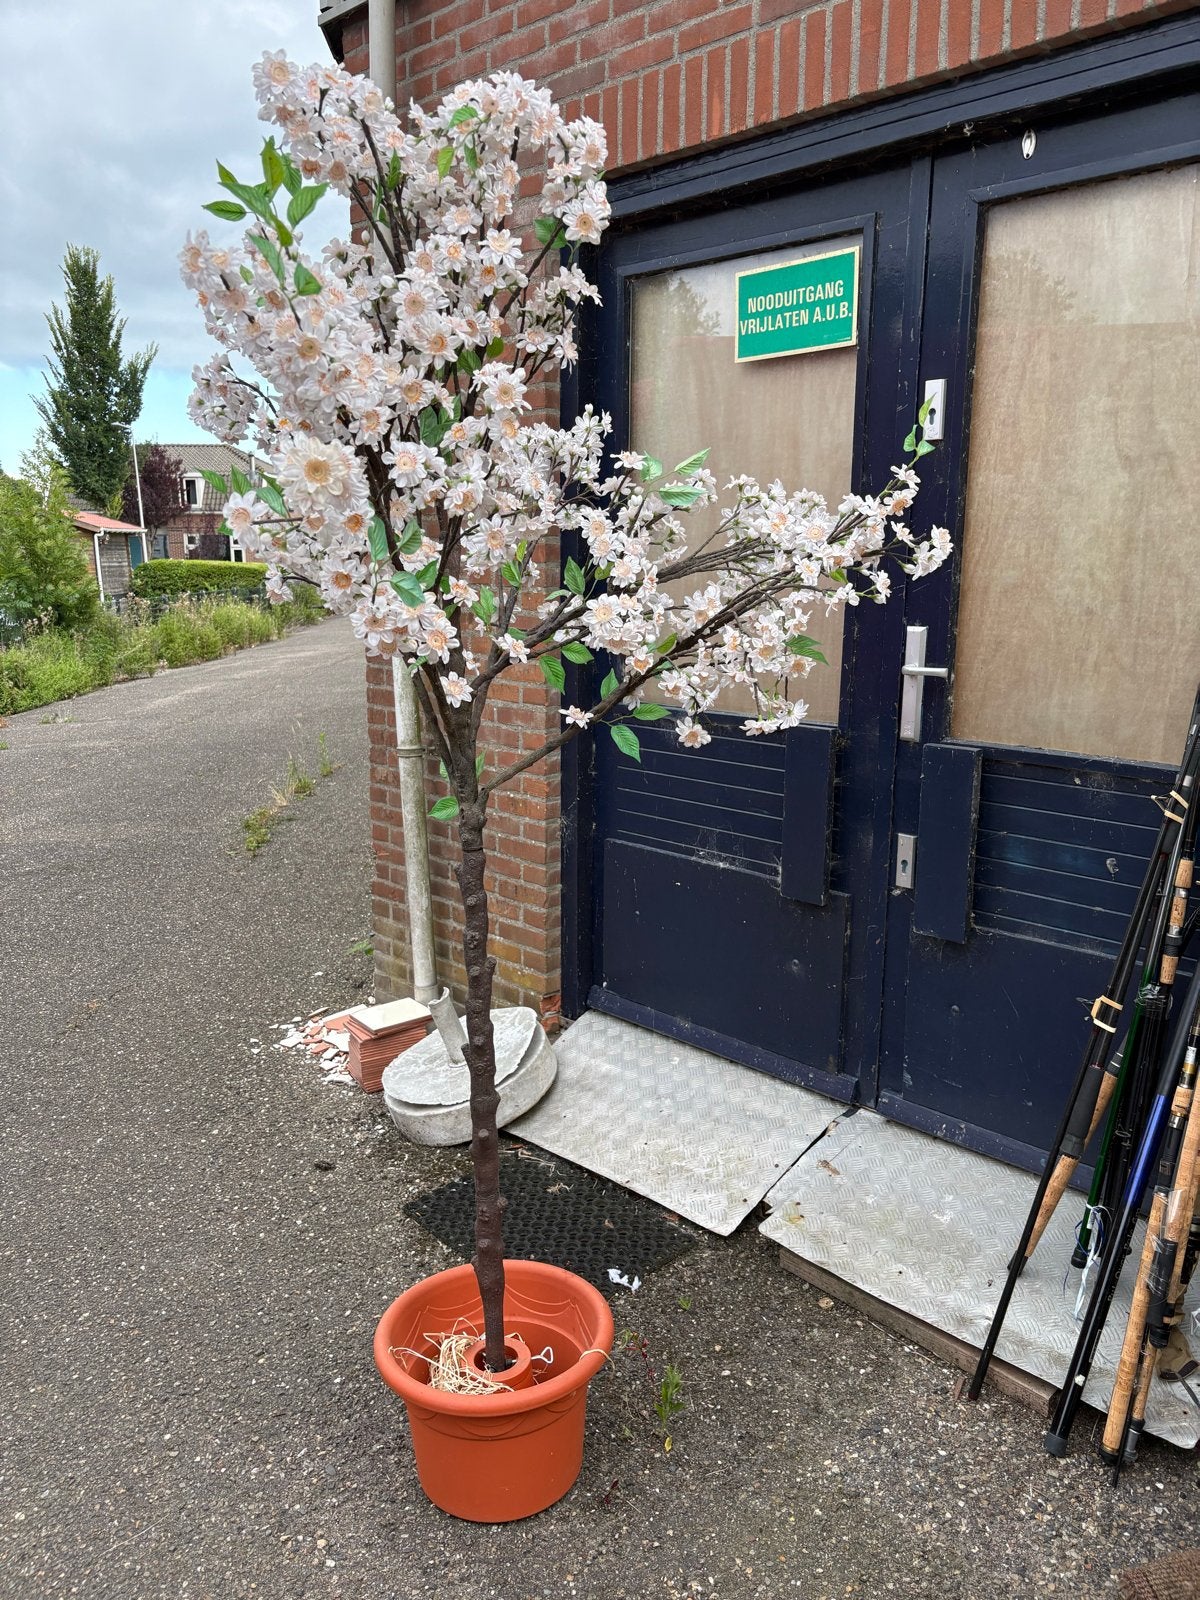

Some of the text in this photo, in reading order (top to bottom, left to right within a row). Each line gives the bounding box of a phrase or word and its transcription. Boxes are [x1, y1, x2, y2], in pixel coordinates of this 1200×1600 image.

[748, 280, 844, 314] NOODUITGANG
[740, 301, 853, 336] VRIJLATEN A.U.B.
